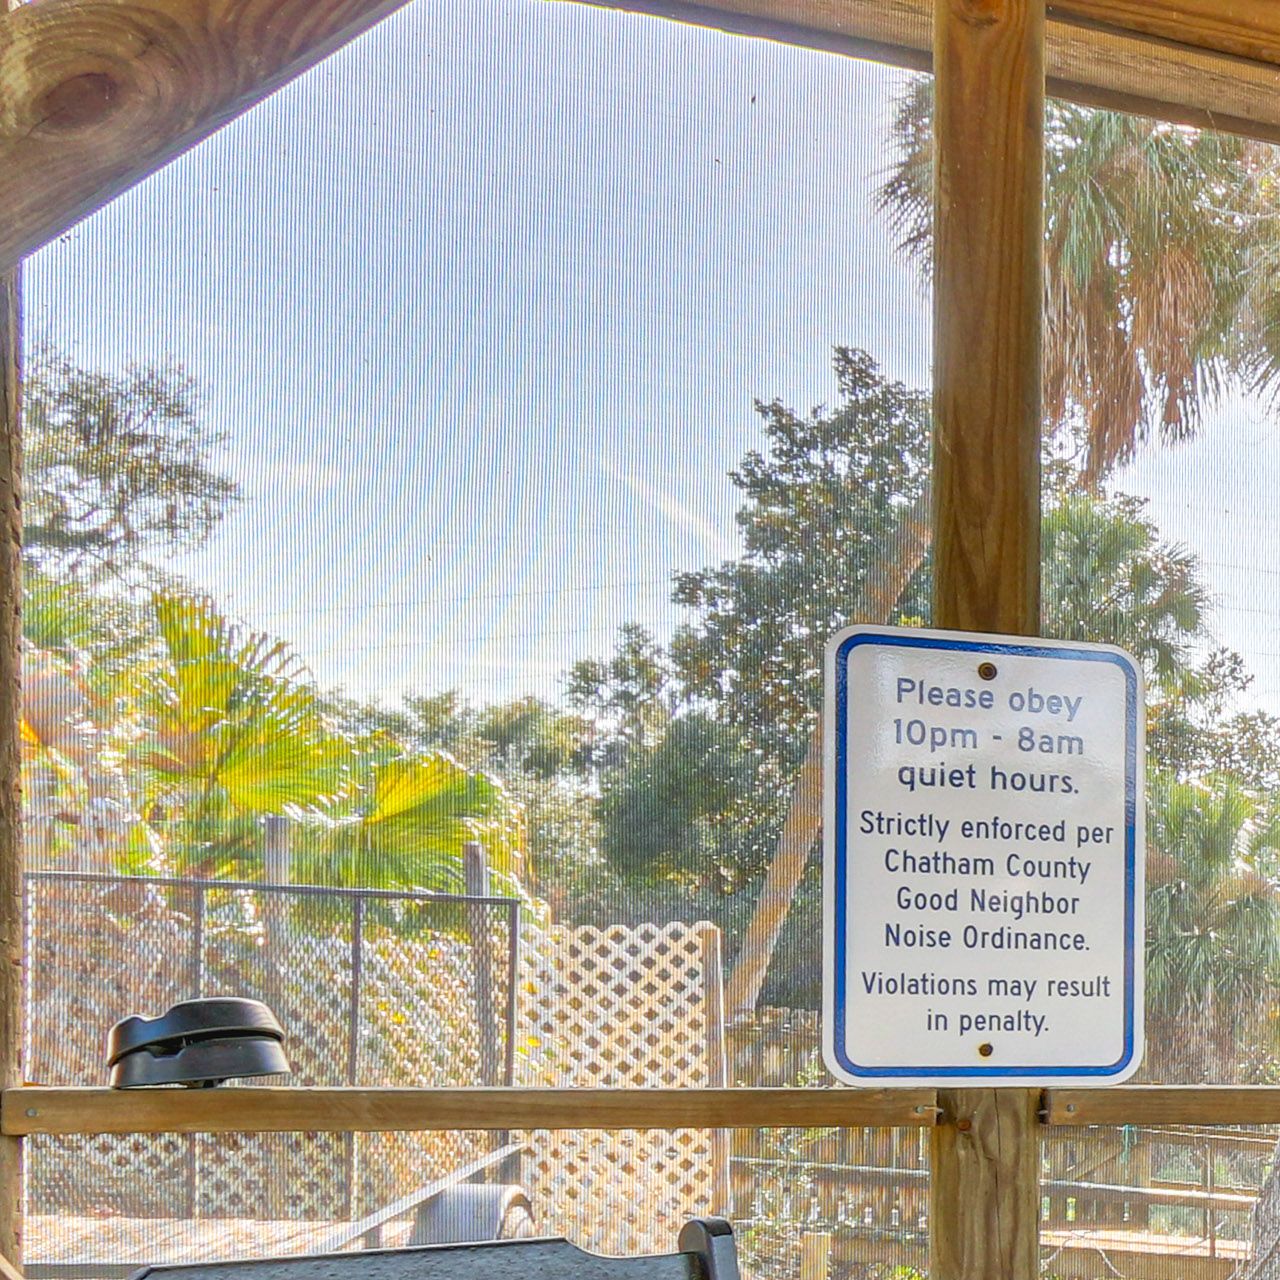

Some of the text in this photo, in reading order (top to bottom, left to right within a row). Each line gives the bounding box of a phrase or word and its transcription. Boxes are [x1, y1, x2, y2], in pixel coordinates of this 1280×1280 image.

[897, 677, 1082, 720] Please obey
[894, 719, 977, 752] 10pm
[1018, 727, 1083, 755] 8am
[899, 762, 1078, 793] quiet hours.
[860, 811, 1114, 848] Strictly enforced per
[885, 849, 1091, 884] Chatham County
[898, 887, 1079, 920] Good Neighbor
[886, 924, 1089, 950] Noise Ordinance.
[862, 972, 1110, 1001] Violations may result
[928, 1009, 1048, 1036] in penalty.
